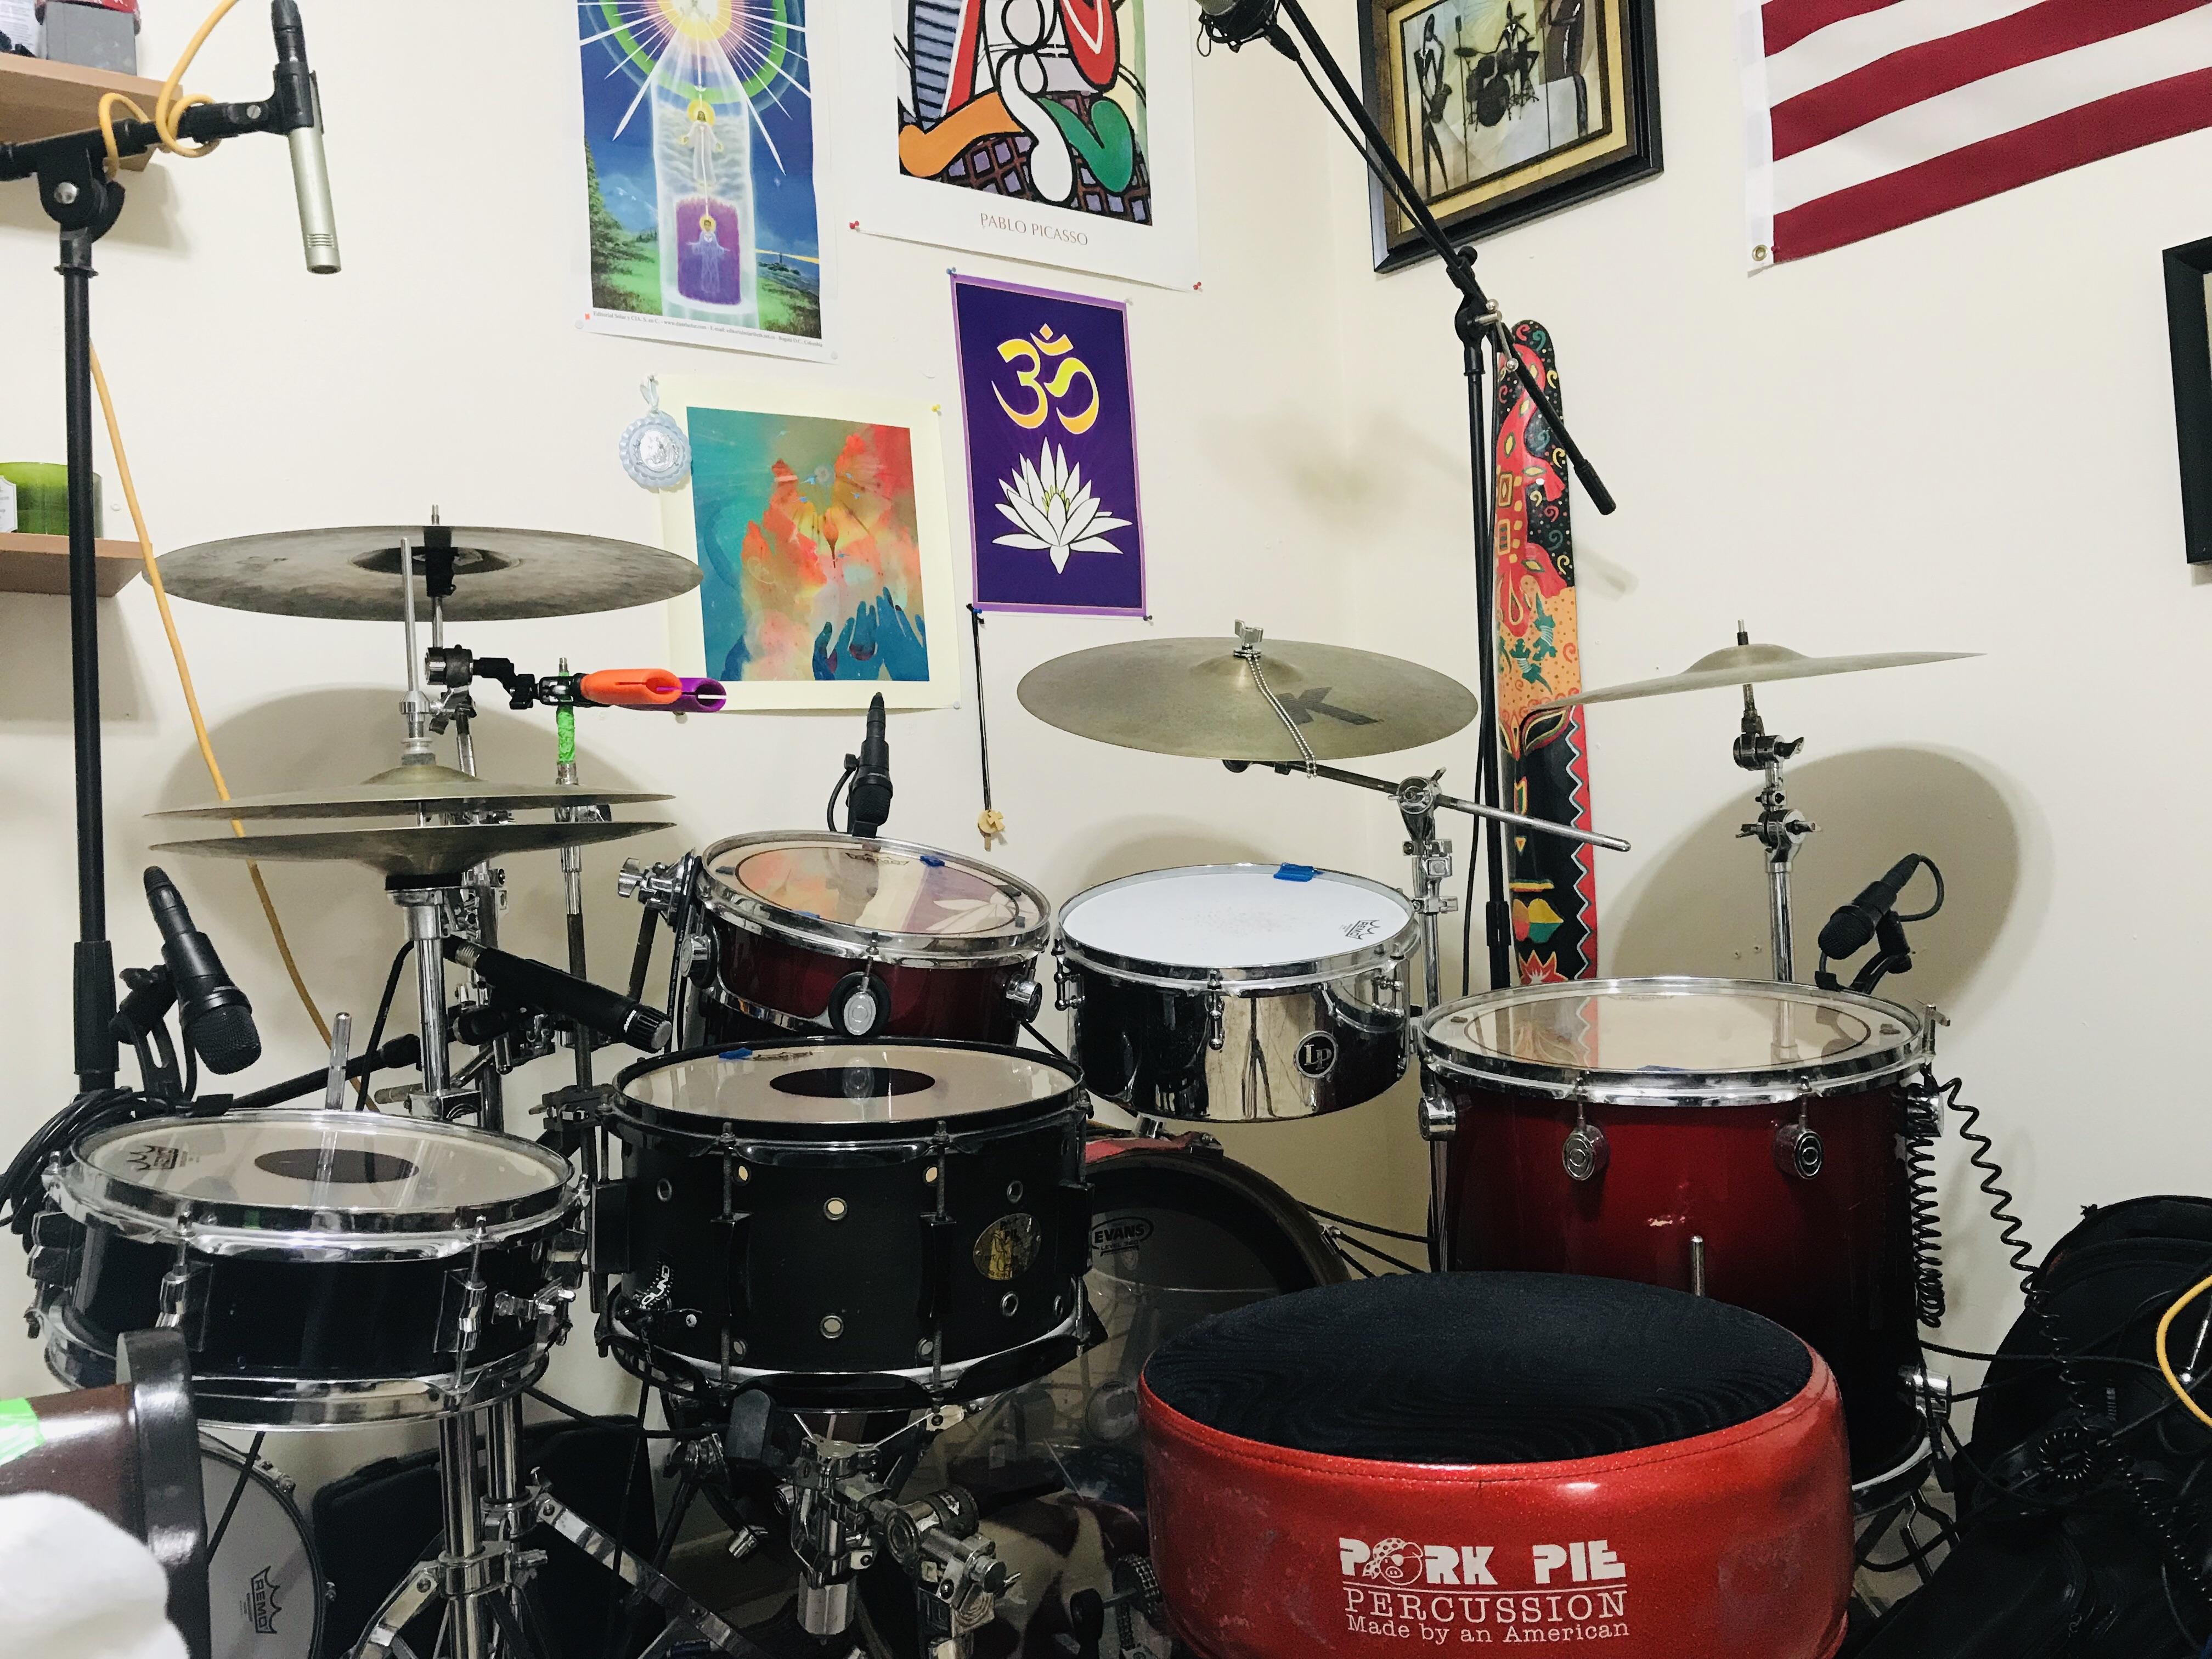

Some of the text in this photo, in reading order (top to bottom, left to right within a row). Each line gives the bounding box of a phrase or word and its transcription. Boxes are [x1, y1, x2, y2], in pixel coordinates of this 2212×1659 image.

[980, 213, 1088, 245] PABLO PICASSO
[1275, 686, 1379, 725] K
[1304, 1043, 1332, 1070] LP
[1094, 1223, 1144, 1244] EVANS
[639, 1265, 670, 1309] OUND
[1532, 1540, 1626, 1584] PIE
[255, 1579, 268, 1628] REMO
[1343, 1587, 1628, 1623] PERCUSSION
[1346, 1614, 1629, 1645] Made by an American
